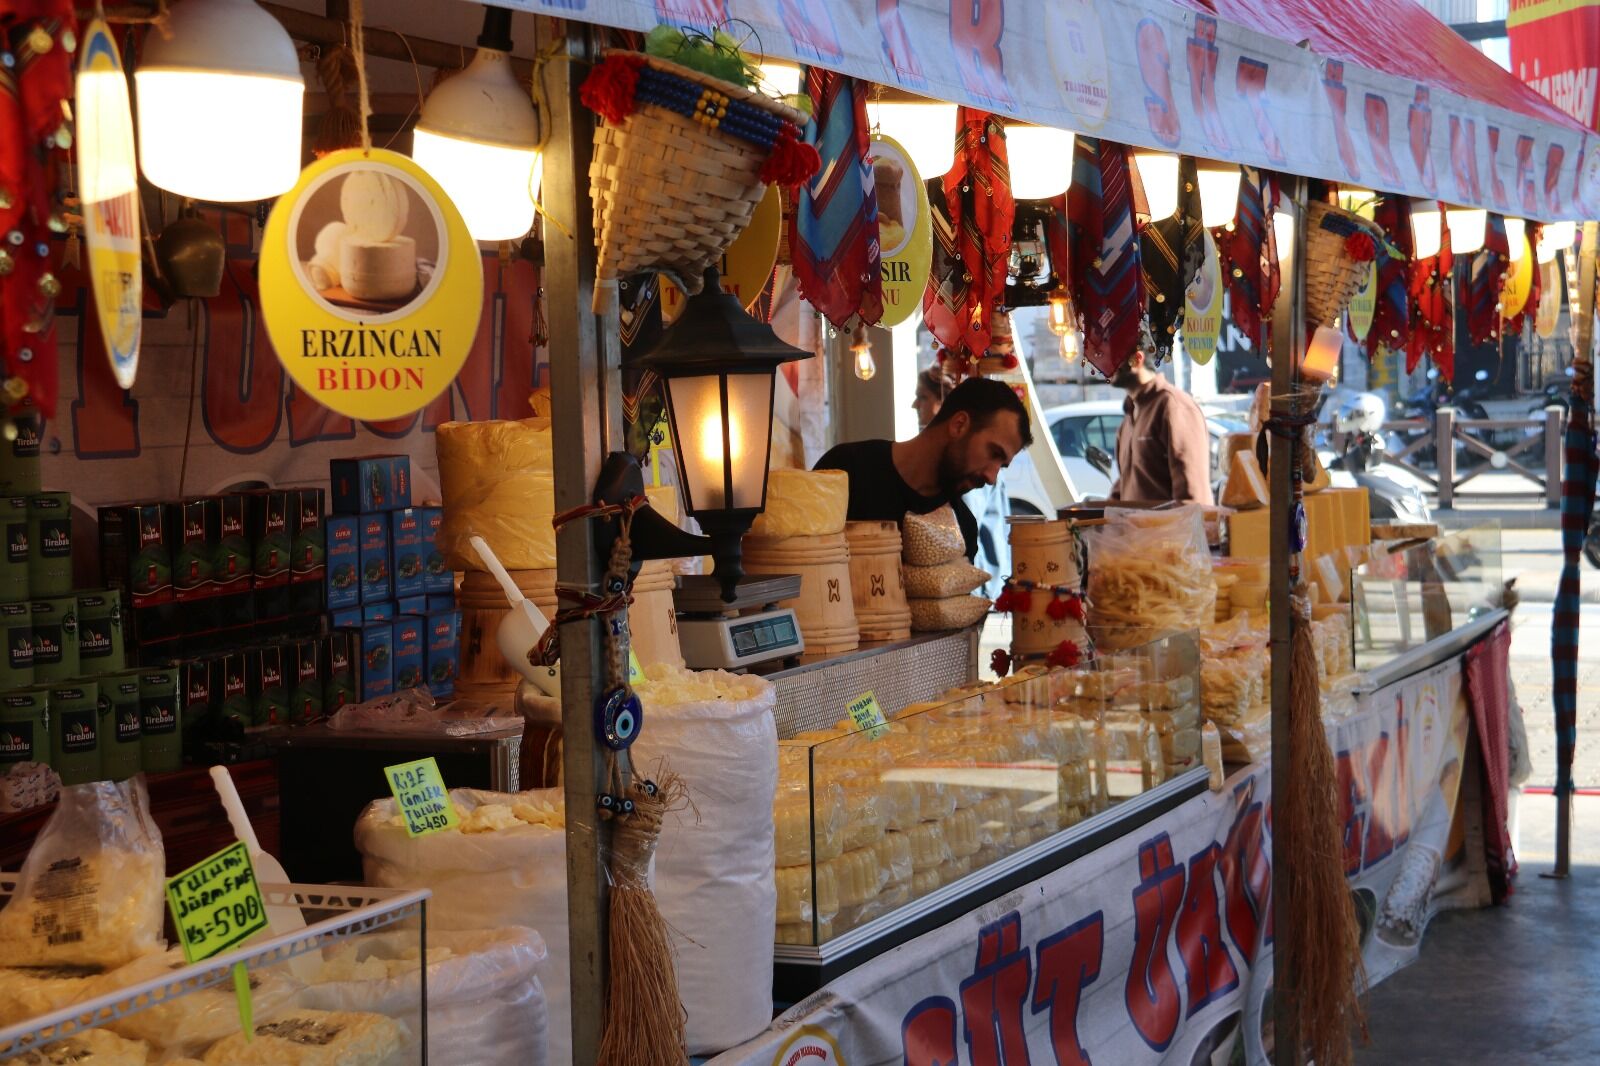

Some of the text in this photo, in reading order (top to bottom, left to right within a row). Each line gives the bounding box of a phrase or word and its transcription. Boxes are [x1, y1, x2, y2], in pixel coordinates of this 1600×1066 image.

[1135, 13, 1286, 166] SÜT
[881, 262, 911, 282] SIR
[882, 289, 900, 306] NU
[1187, 317, 1214, 333] KOLOT
[302, 321, 443, 358] ERZİNCAN
[318, 361, 425, 391] BİDON
[145, 714, 174, 725] Tirebolu
